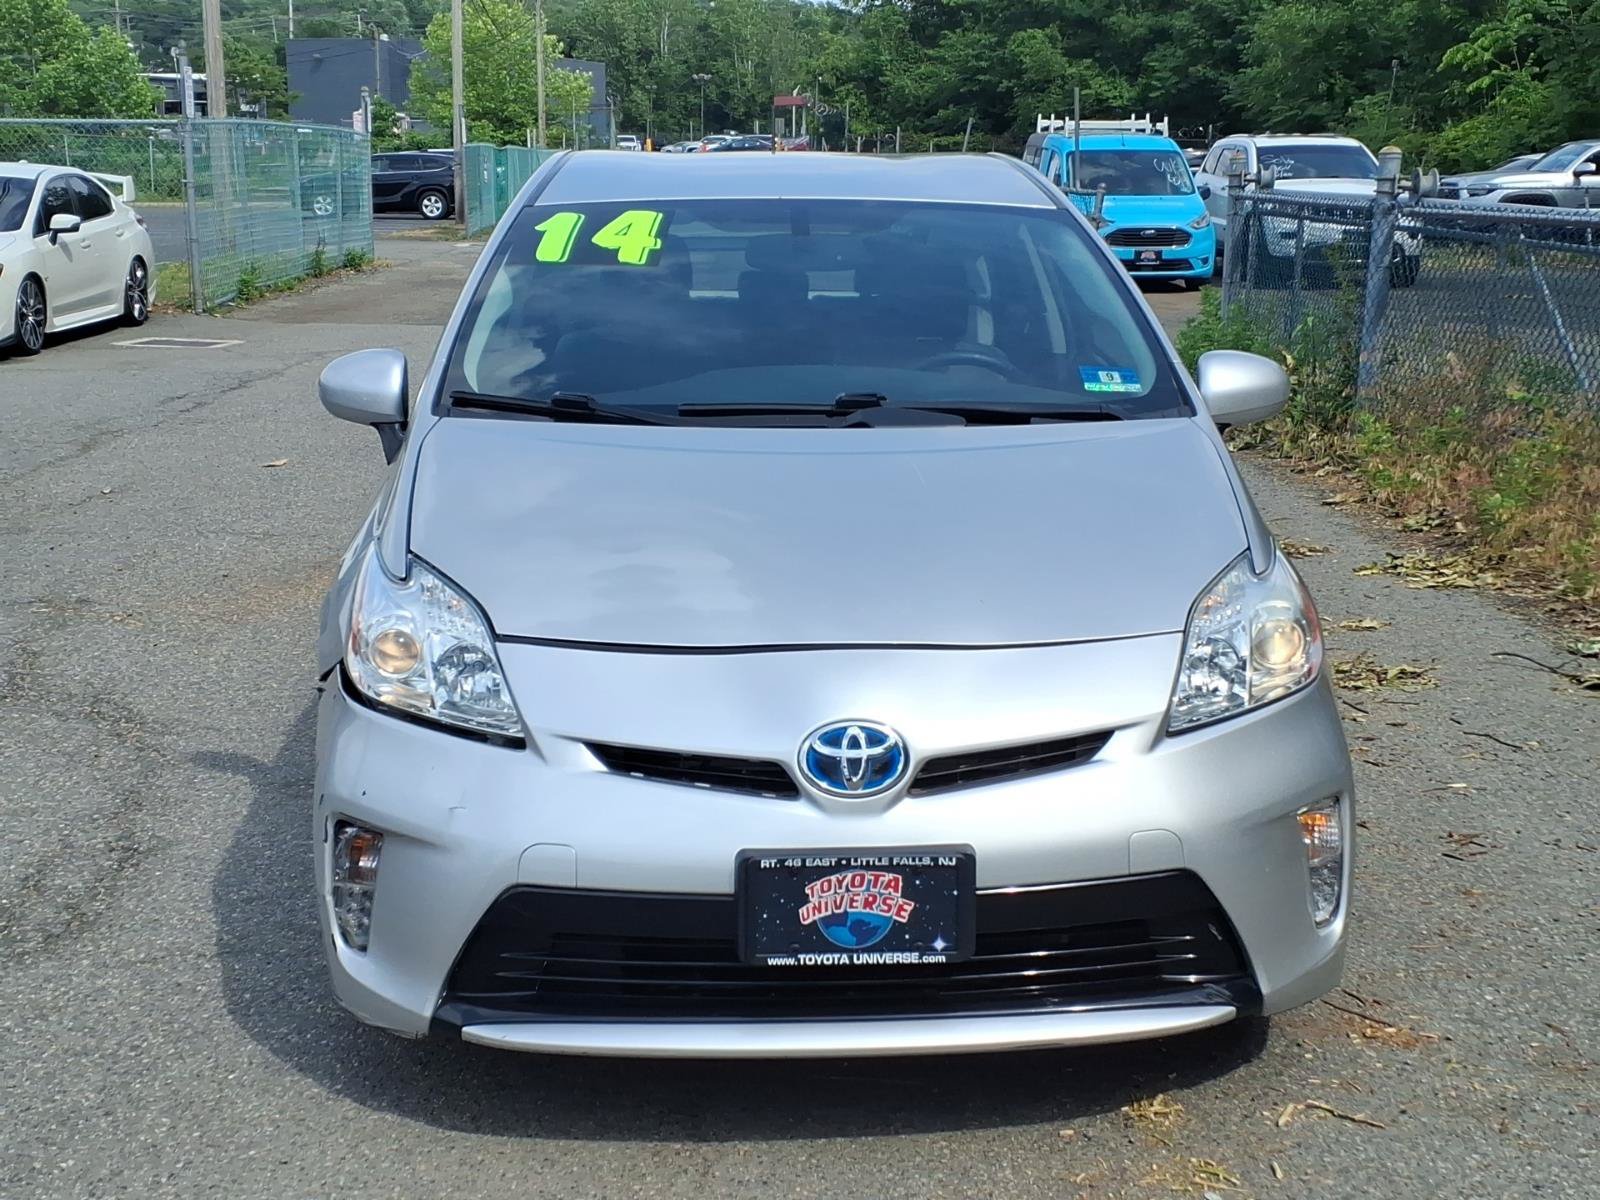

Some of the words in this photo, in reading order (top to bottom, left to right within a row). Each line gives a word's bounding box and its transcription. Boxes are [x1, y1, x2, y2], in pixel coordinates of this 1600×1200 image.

[534, 210, 663, 265] 14
[1105, 372, 1115, 382] 9
[760, 858, 780, 869] RT.
[784, 858, 802, 868] 46
[805, 857, 838, 867] EAST
[850, 857, 889, 867] LITTLE
[892, 856, 934, 867] FALLS,
[938, 856, 957, 866] NJ
[805, 871, 902, 902] TOYOTA
[799, 892, 915, 925] UNIVERSE
